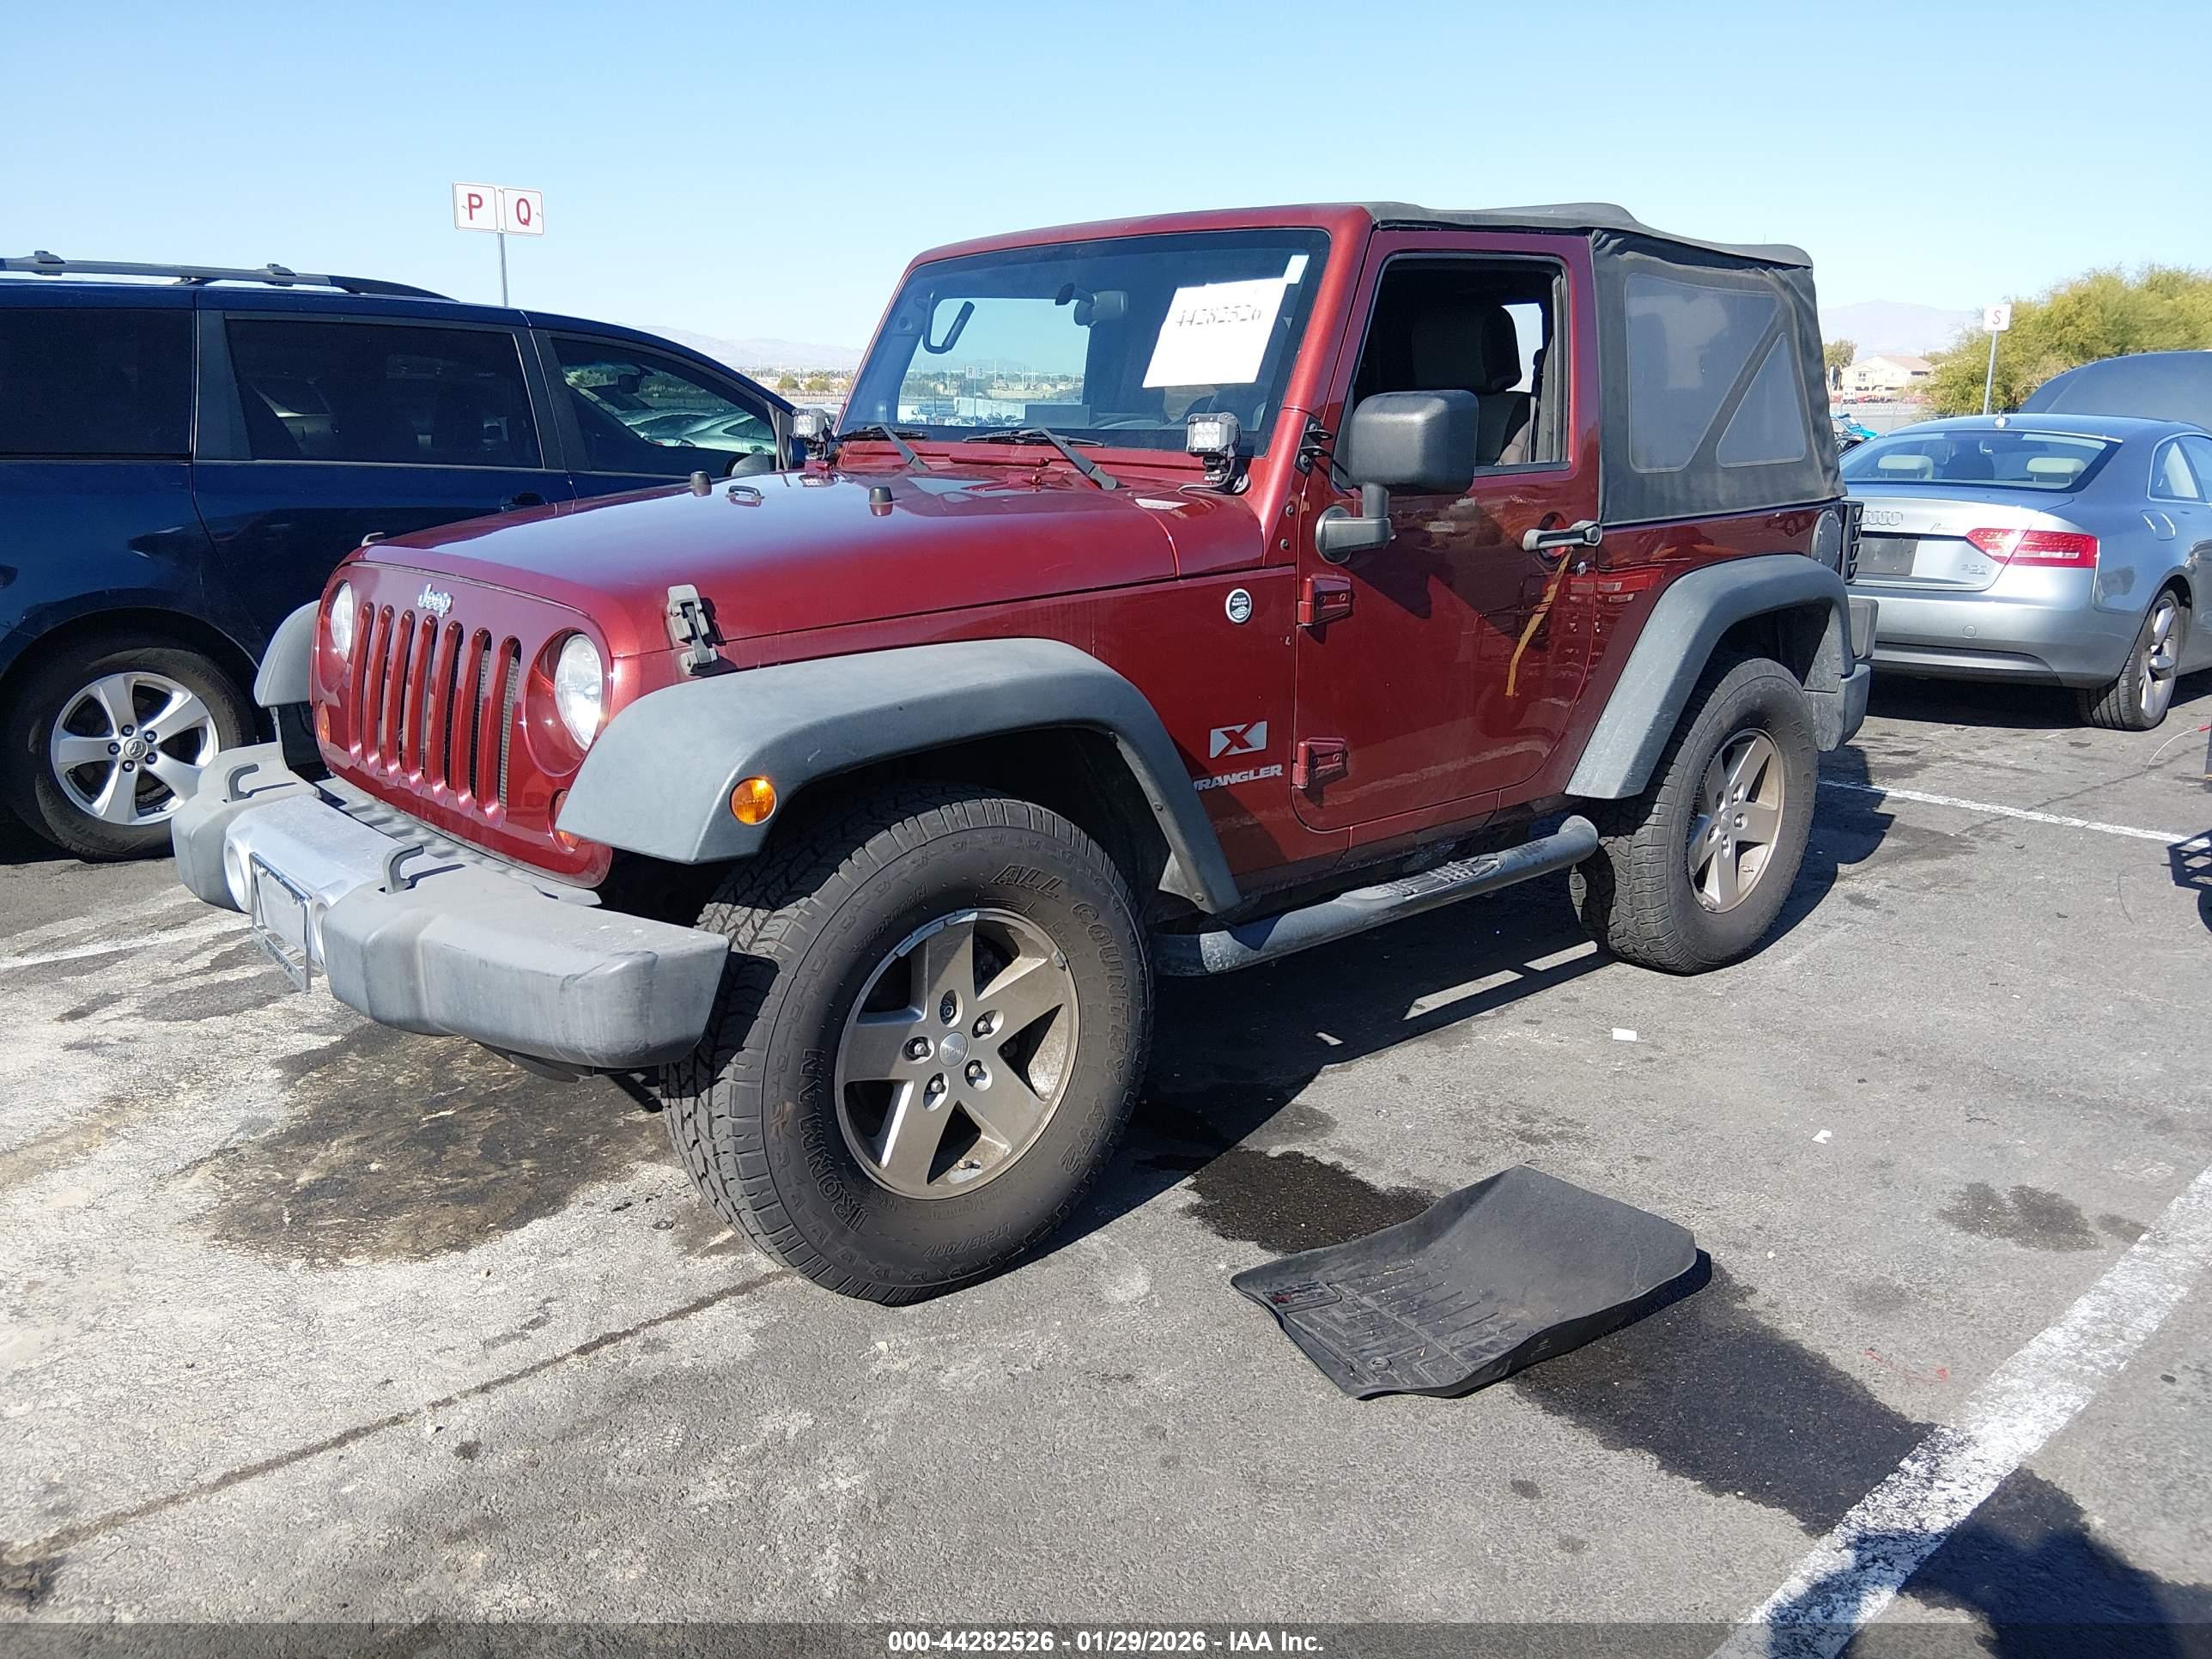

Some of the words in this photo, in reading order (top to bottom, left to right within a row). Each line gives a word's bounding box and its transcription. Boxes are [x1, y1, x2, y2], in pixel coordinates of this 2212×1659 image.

[467, 193, 483, 221] P
[516, 198, 532, 227] Q
[1992, 309, 2002, 325] S
[968, 367, 973, 378] R
[978, 367, 984, 378] S
[417, 583, 453, 618] Jeep
[1212, 721, 1263, 759] X
[989, 863, 1066, 899] ALL
[1071, 902, 1130, 1085] COUNTRY
[798, 1048, 869, 1232] IRONMAN
